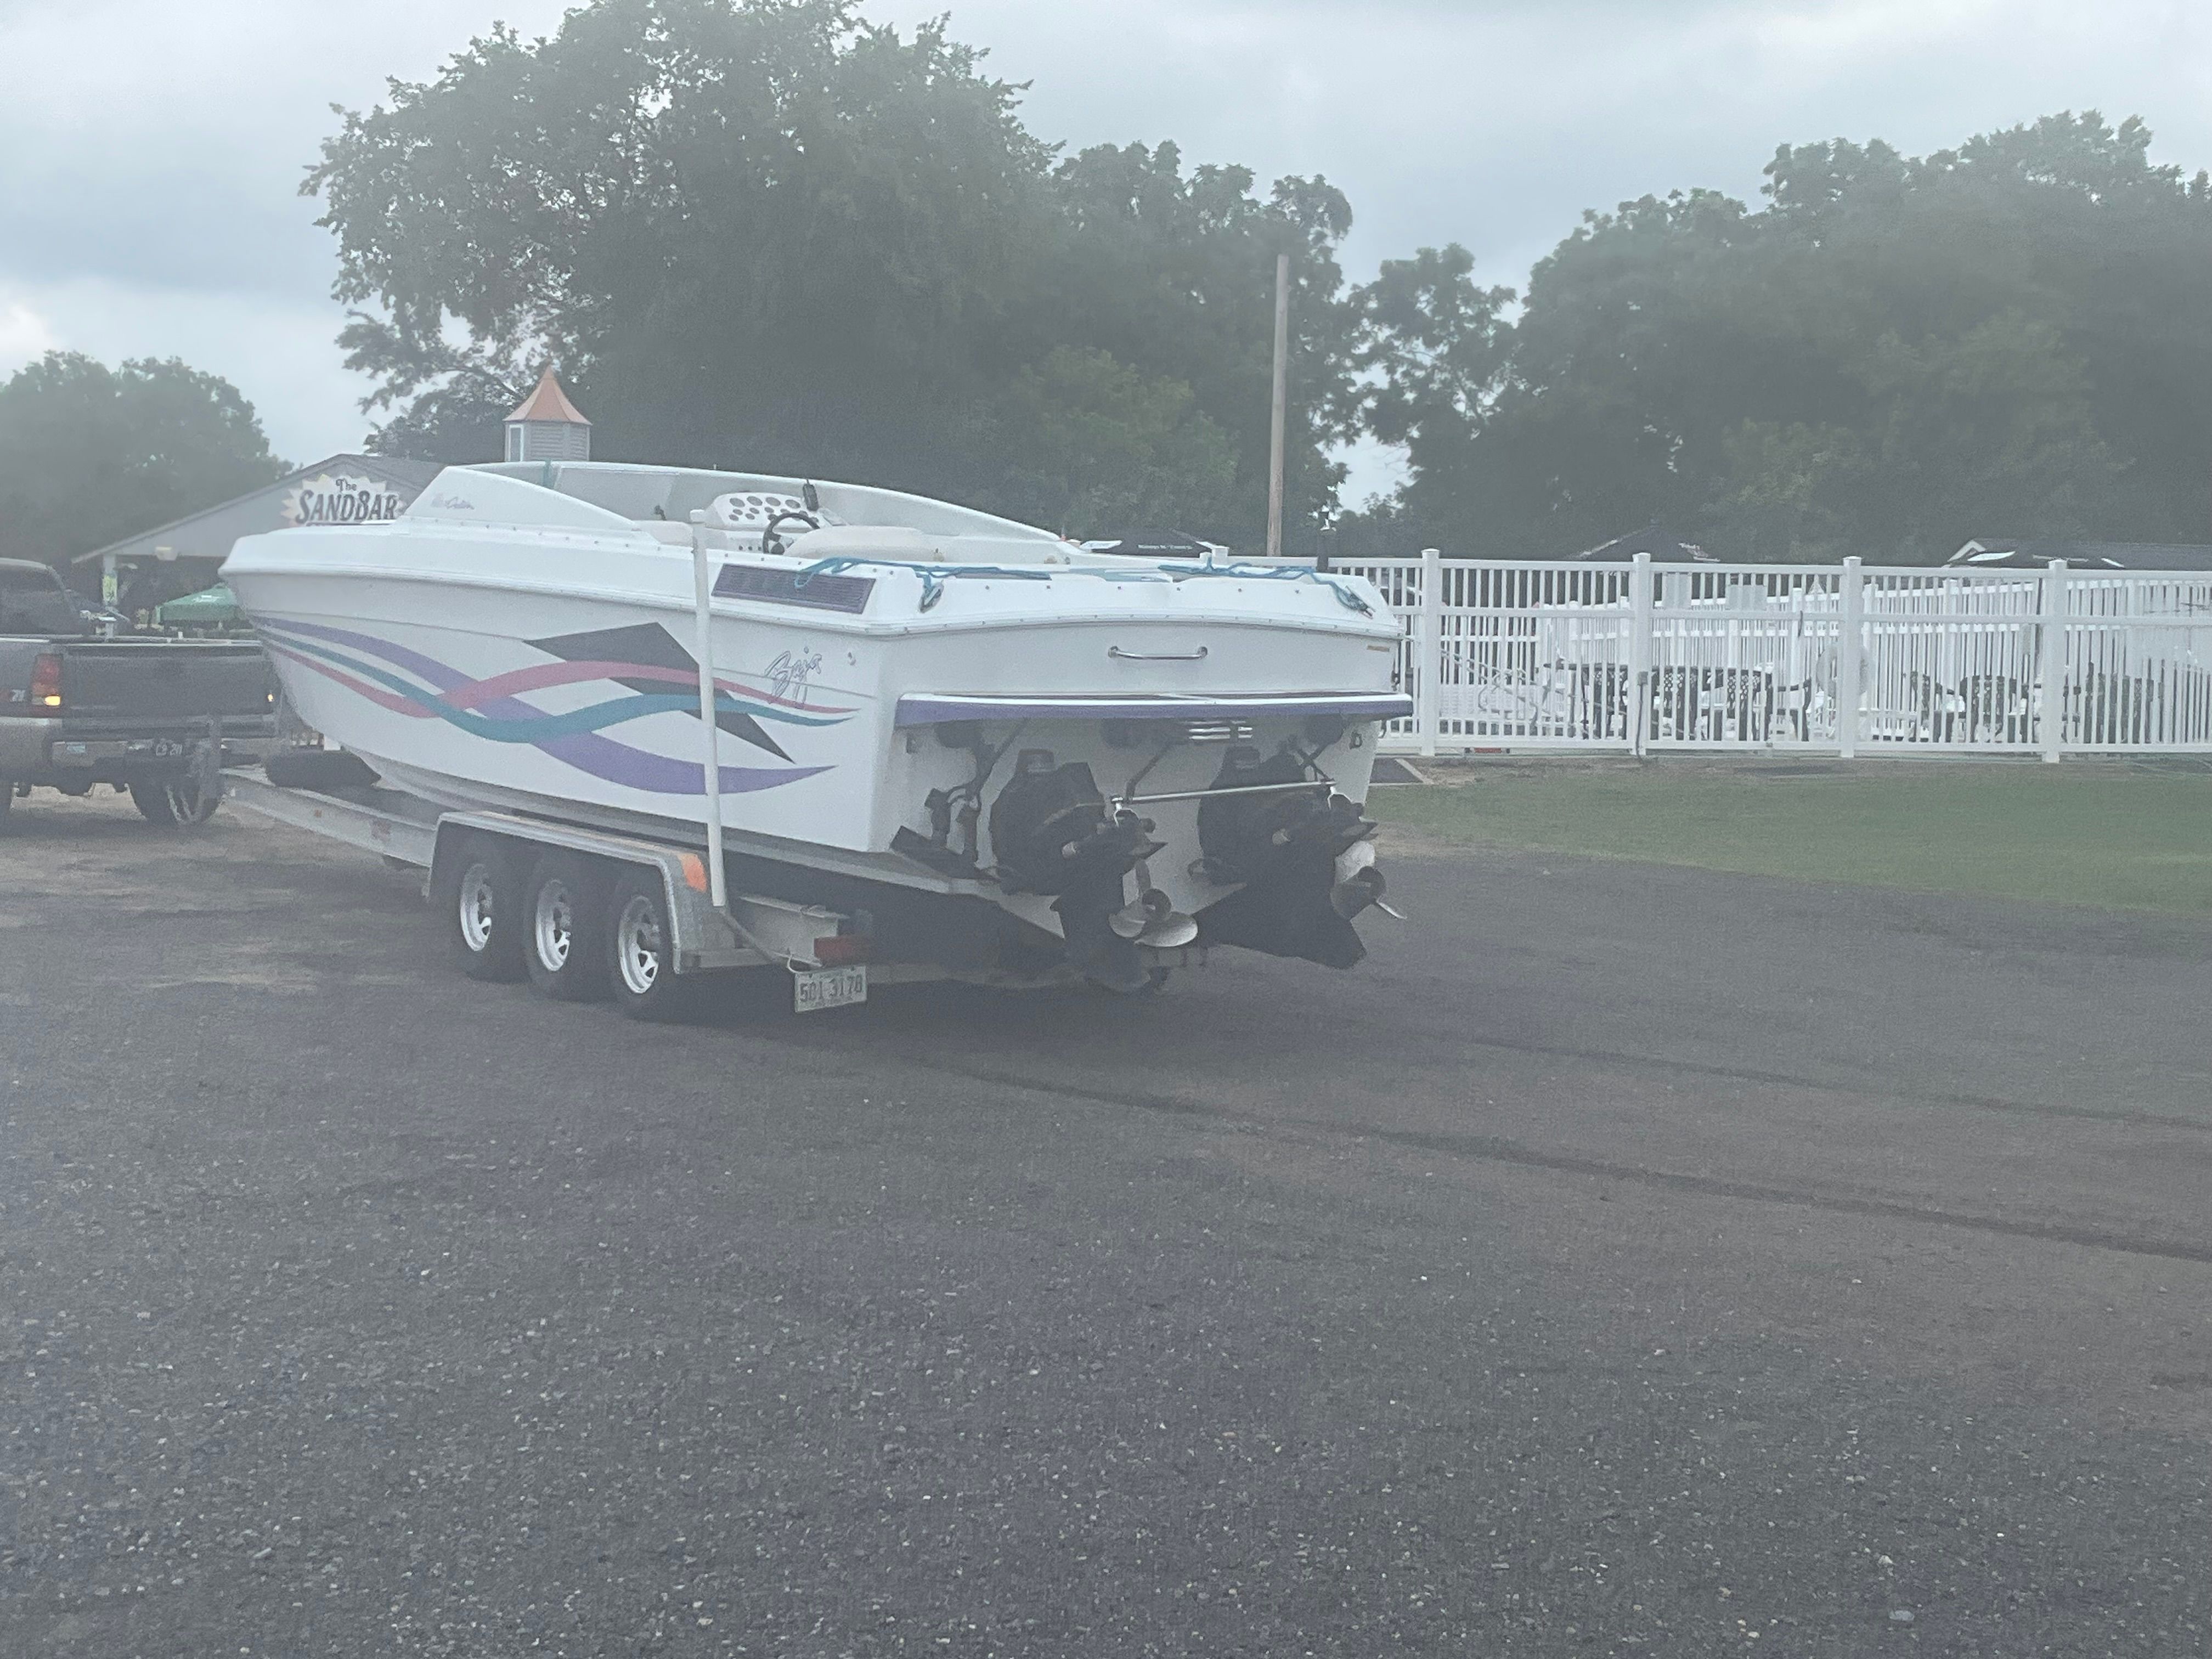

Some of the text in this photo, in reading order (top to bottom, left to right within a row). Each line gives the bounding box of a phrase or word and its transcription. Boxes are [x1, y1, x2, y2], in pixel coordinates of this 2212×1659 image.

[335, 478, 357, 493] The
[296, 489, 399, 522] SANDBAR
[764, 646, 822, 706] Baja
